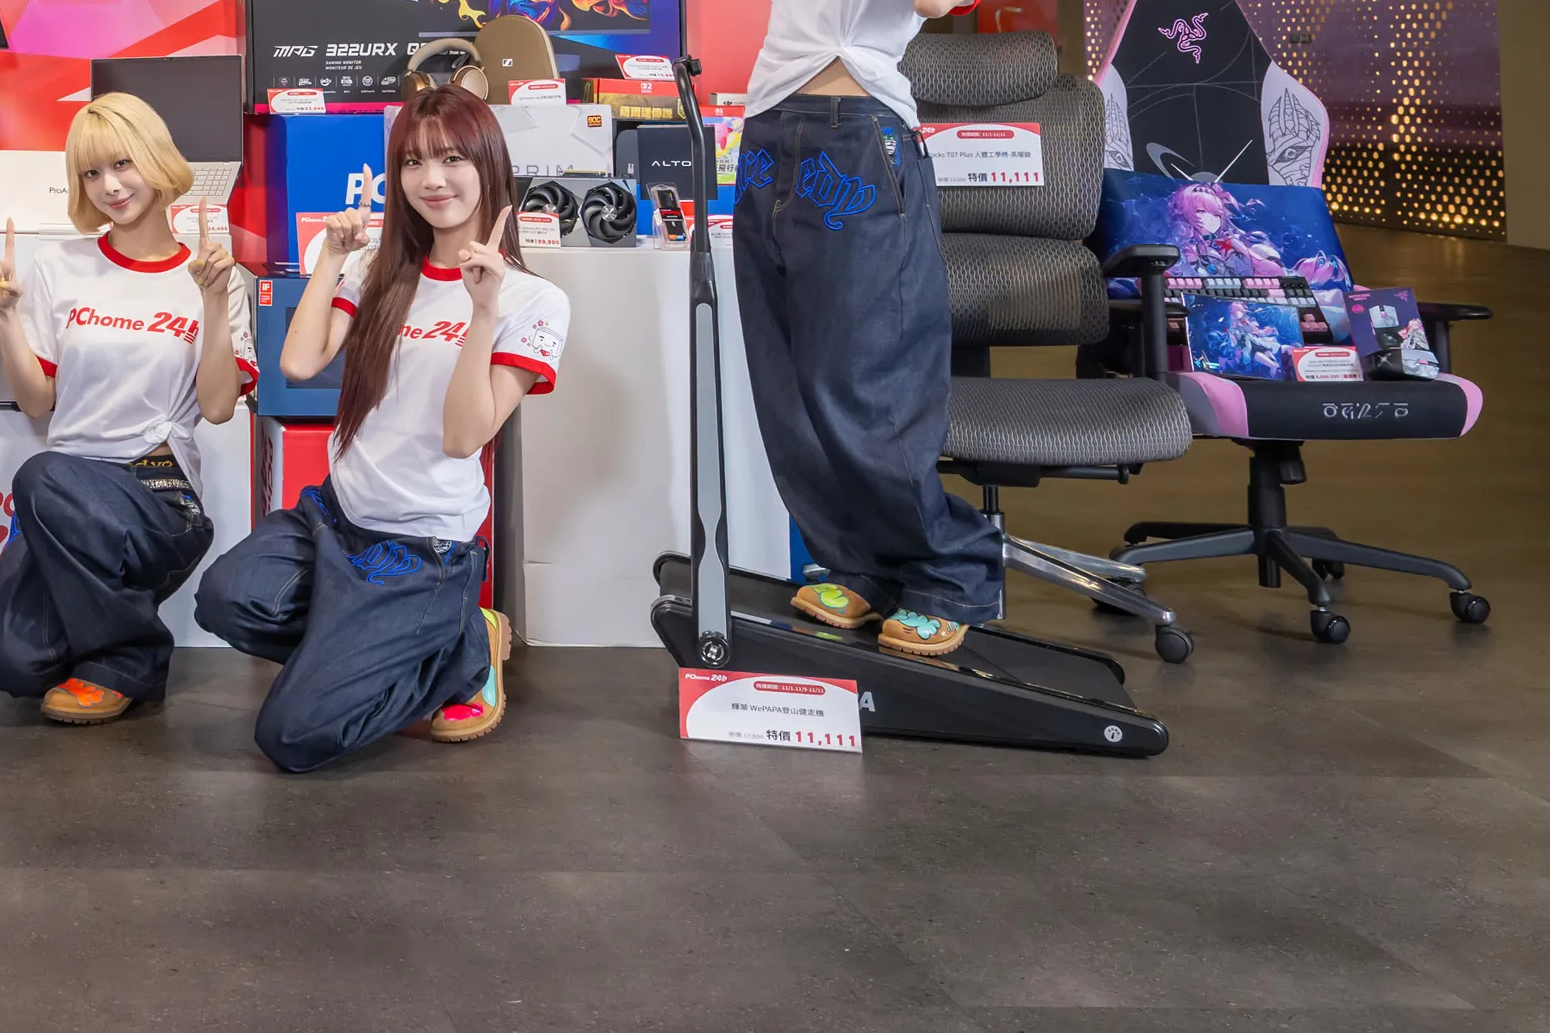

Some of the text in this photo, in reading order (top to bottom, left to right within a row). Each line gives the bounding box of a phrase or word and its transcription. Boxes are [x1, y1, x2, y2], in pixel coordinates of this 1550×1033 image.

[273, 45, 318, 58] MPG
[326, 42, 398, 57] 322URX
[968, 172, 988, 183] 特價
[991, 172, 1039, 184] 11,111
[49, 186, 68, 194] ProA
[66, 307, 199, 344] PChome 24h
[685, 673, 727, 682] PChome 24h
[766, 729, 791, 742] 特價
[795, 730, 857, 747] 11,111
